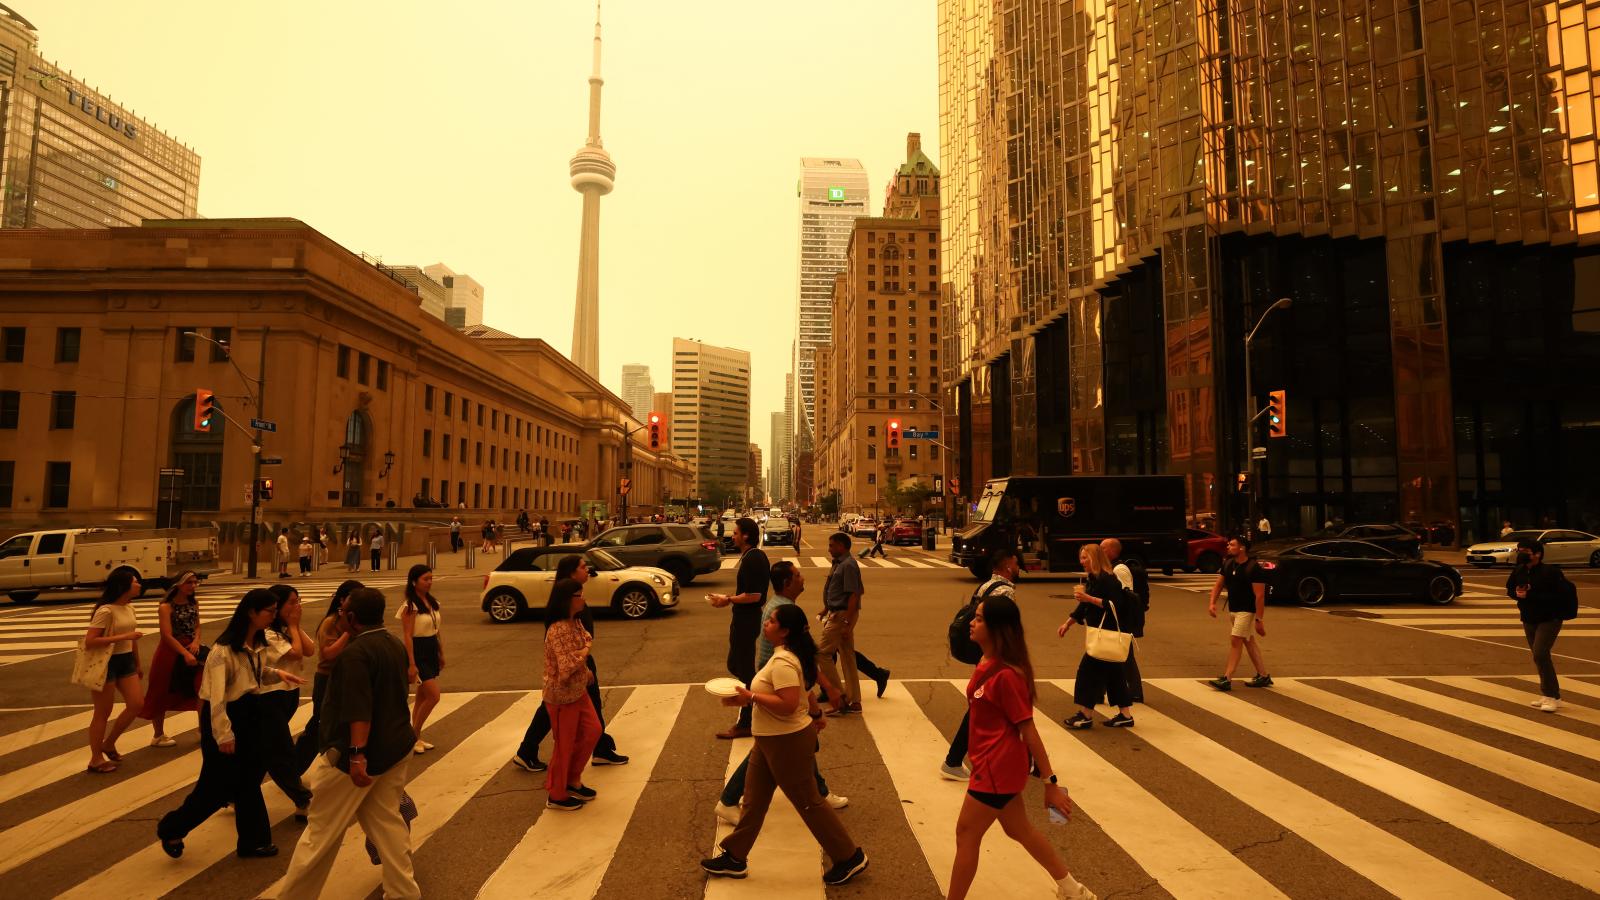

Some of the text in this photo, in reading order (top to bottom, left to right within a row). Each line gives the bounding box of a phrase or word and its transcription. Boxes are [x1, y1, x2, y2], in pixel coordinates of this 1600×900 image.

[67, 87, 137, 140] TELUS
[831, 189, 843, 198] TD
[912, 431, 924, 439] Bay
